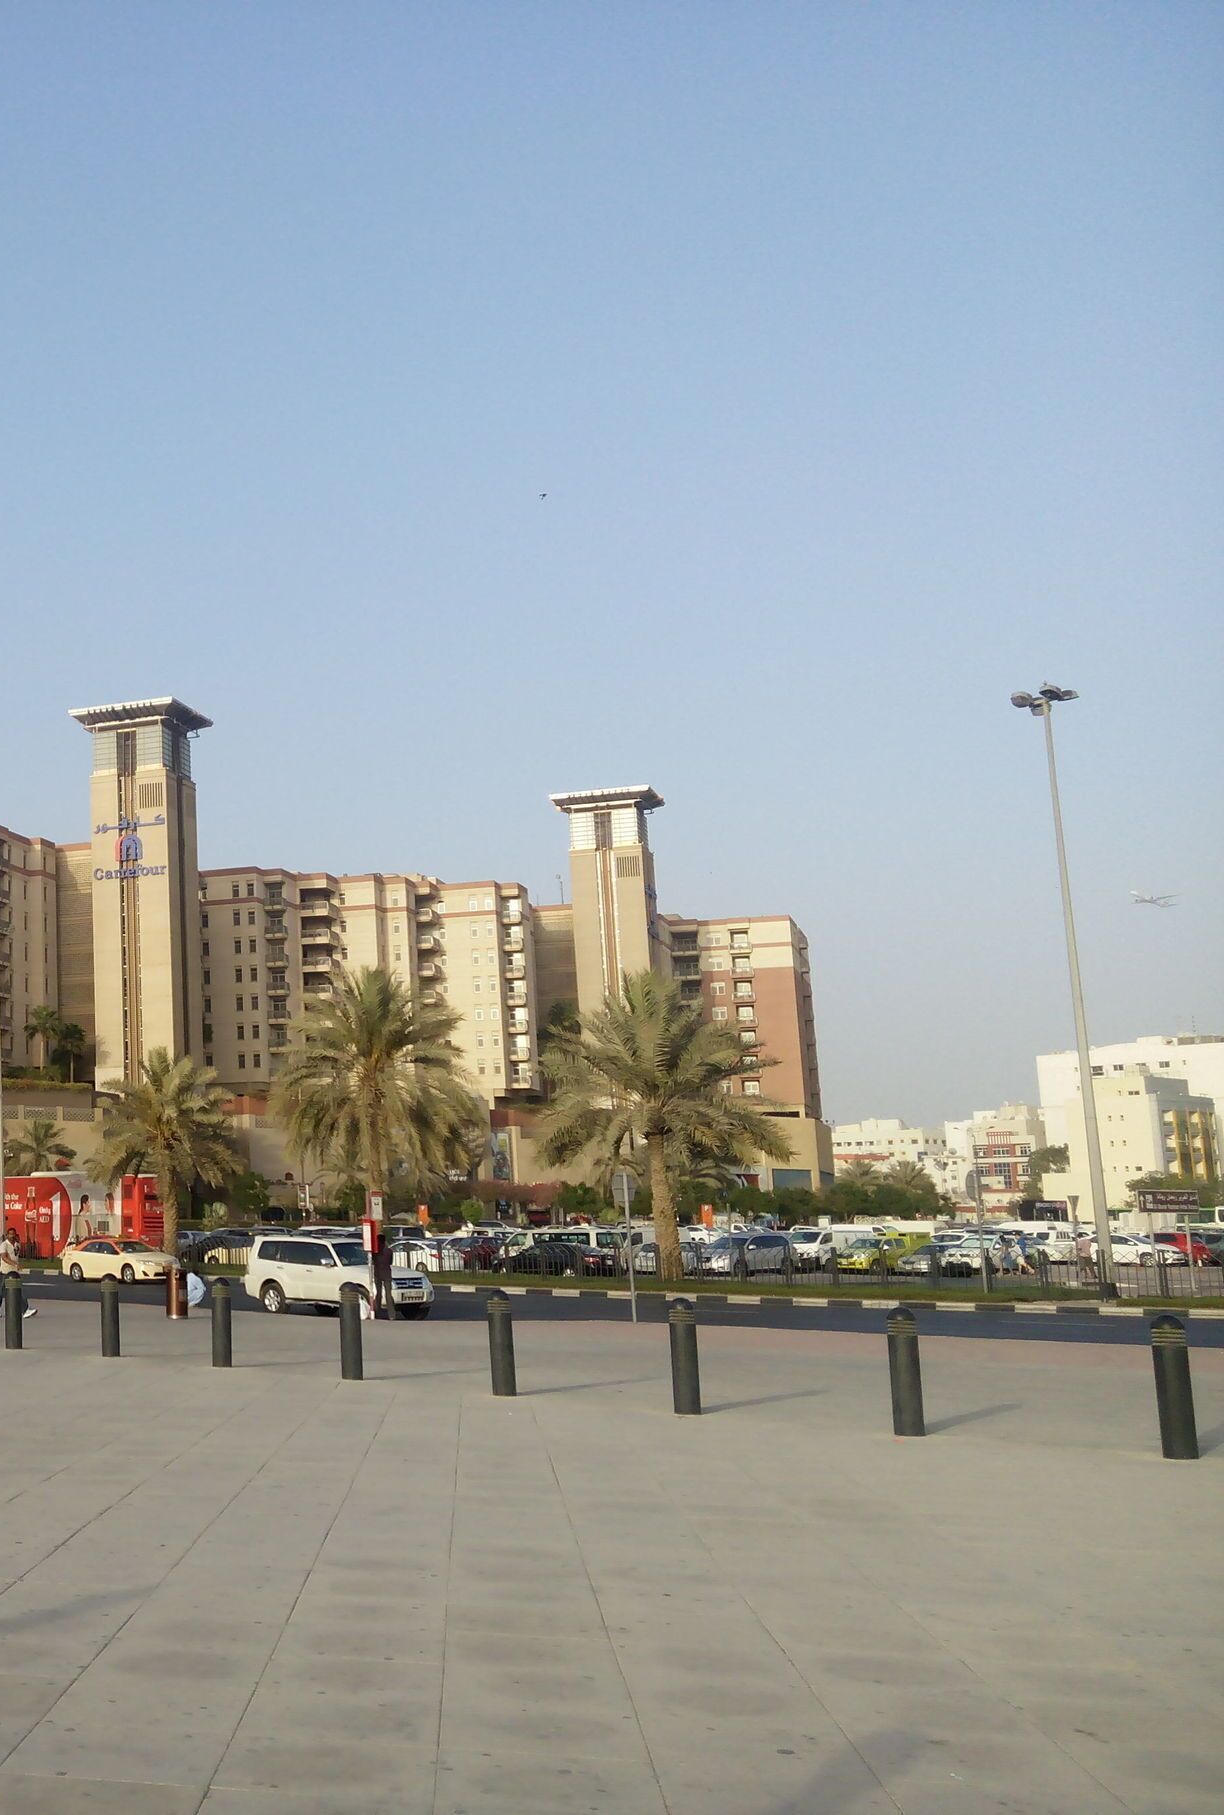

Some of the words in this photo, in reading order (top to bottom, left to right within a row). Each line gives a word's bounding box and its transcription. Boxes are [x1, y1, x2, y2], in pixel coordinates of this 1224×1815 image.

[94, 864, 167, 880] Carrefour
[39, 1206, 51, 1215] Only
[49, 1191, 60, 1241] 1
